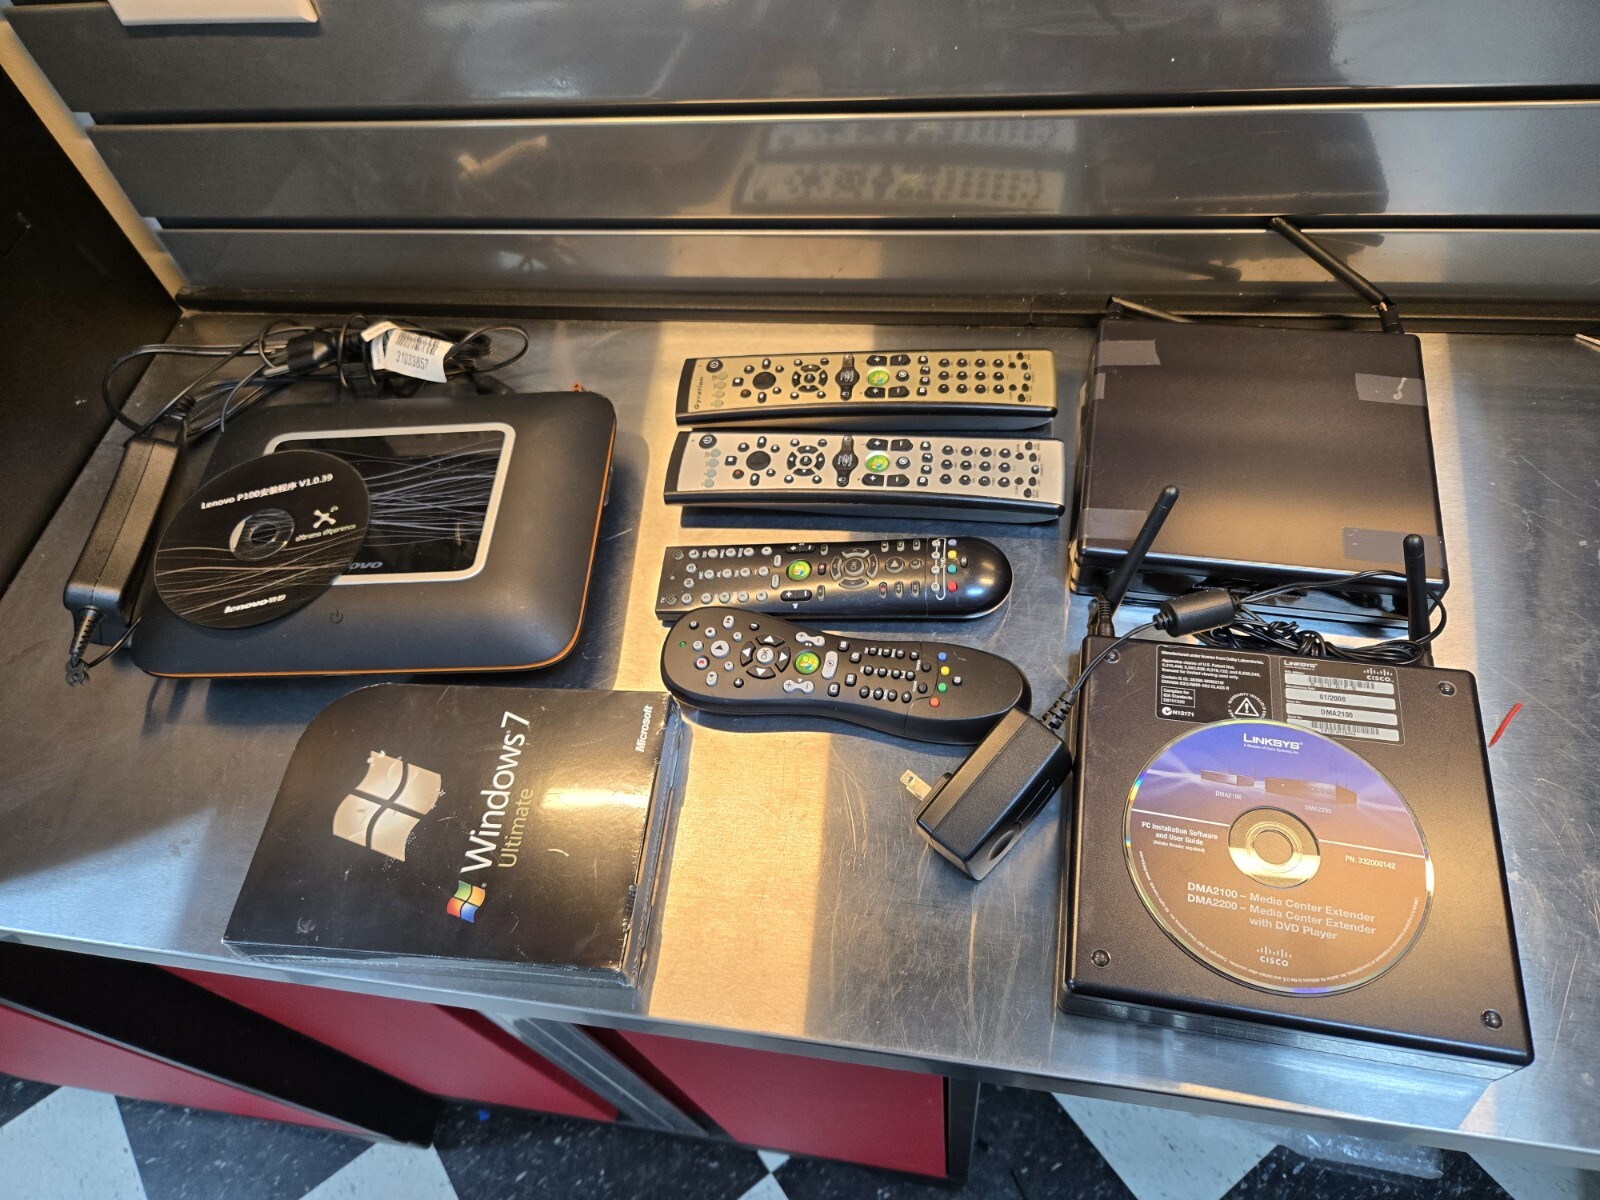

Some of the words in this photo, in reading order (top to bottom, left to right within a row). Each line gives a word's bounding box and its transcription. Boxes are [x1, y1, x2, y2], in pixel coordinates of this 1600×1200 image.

[396, 351, 429, 370] 31033857
[694, 376, 704, 409] Gyration
[201, 497, 235, 510] Lenovo
[298, 473, 333, 488] V1.0.39
[850, 560, 857, 571] OK
[761, 648, 769, 659] OK
[1319, 693, 1346, 702] 01/2008
[1320, 708, 1353, 718] DMA2100
[634, 705, 653, 753] Microsoft
[460, 731, 526, 873] Windows
[501, 710, 530, 729] 7
[1215, 790, 1242, 800] DMA2100
[1305, 804, 1332, 815] DMA2200
[498, 788, 534, 869] Ultimate
[1141, 821, 1151, 829] PC
[1152, 823, 1187, 835] Installation
[1189, 829, 1218, 840] Software
[1169, 834, 1184, 842] User
[1185, 837, 1204, 846] Guide
[1344, 855, 1357, 864] PN:
[1358, 857, 1396, 870] 332000142
[1187, 882, 1238, 899] DMA2100
[1250, 892, 1283, 907] Media
[1285, 899, 1322, 913] Center
[1325, 906, 1375, 922] Extender
[1187, 893, 1238, 910] DMA2200
[1250, 904, 1283, 918] Media
[1285, 910, 1323, 925] Center
[1325, 918, 1376, 934] Extender
[1250, 917, 1273, 928] with
[1275, 921, 1300, 933] DVD
[1302, 926, 1338, 940] Player
[1260, 955, 1289, 967] CISCO
